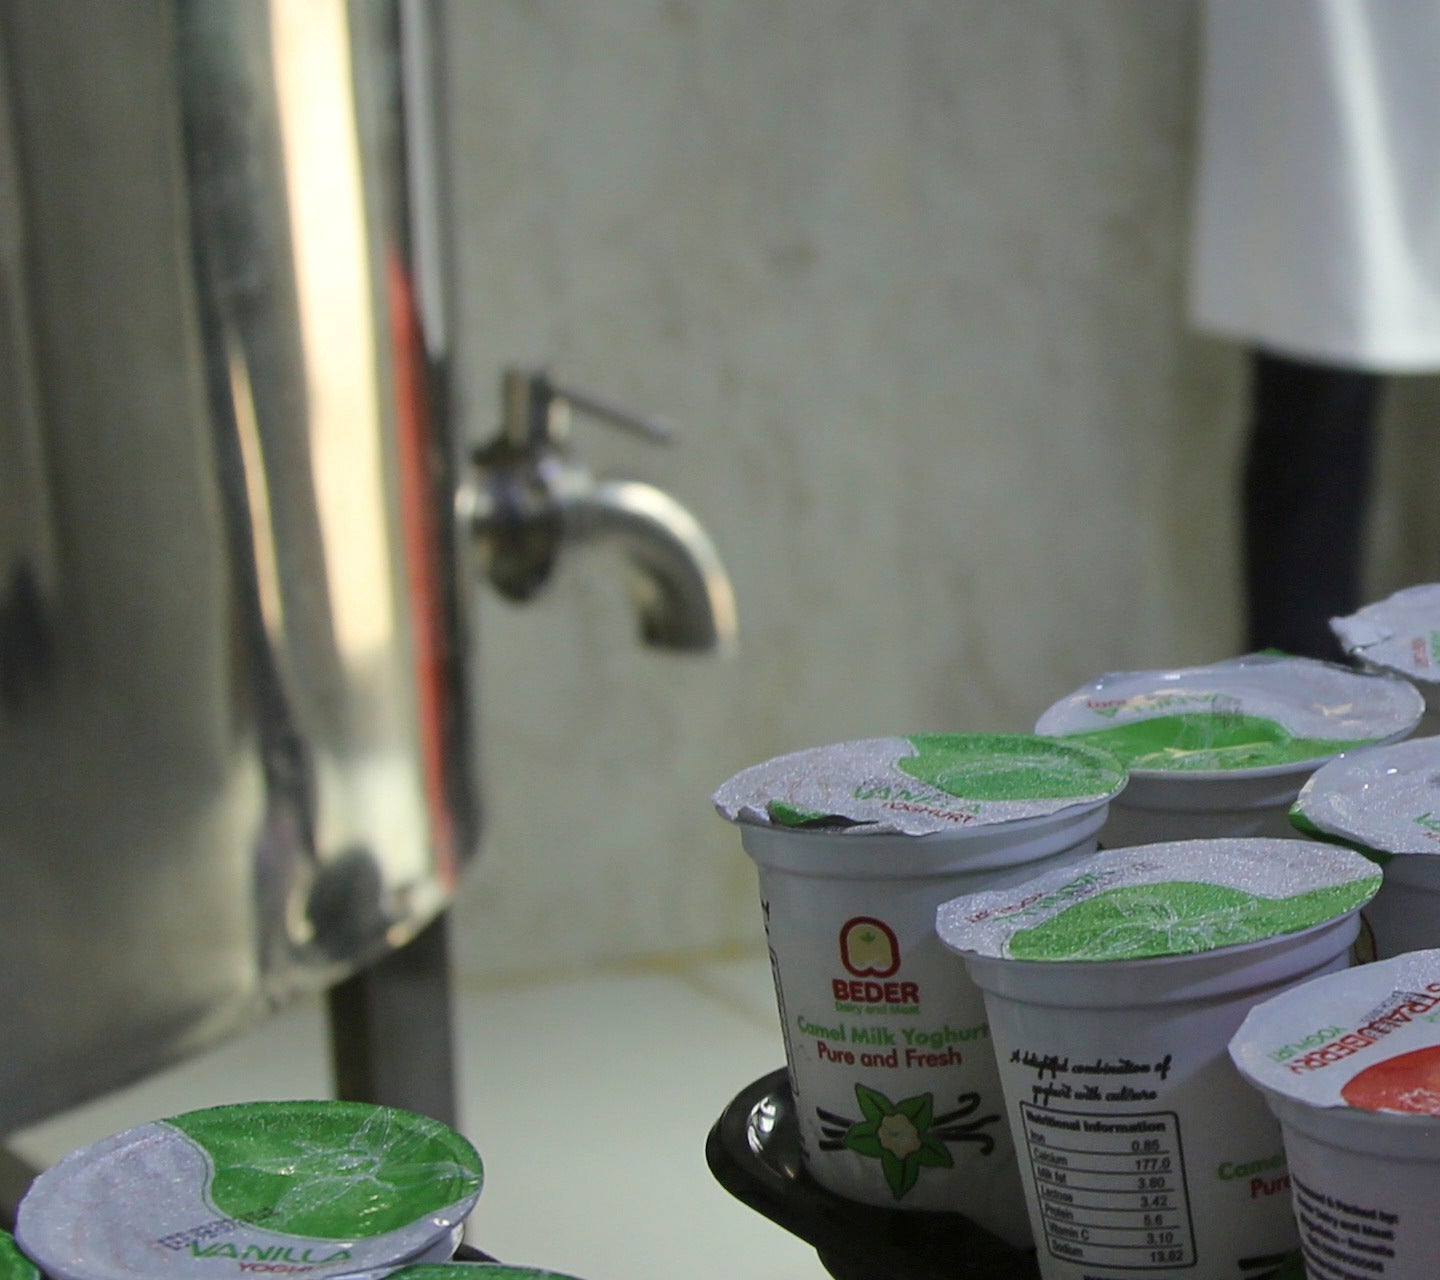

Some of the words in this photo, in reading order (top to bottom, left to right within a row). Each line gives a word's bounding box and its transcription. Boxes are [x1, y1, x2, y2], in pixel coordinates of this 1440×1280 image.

[832, 978, 920, 1004] BEDER
[796, 1015, 847, 1042] Camel
[851, 1026, 896, 1046] Milk
[901, 1021, 989, 1050] Yoghurt
[817, 1040, 855, 1066] Pure
[860, 1049, 898, 1069] and
[905, 1046, 962, 1068] Fresh
[1153, 1053, 1173, 1081] of
[1083, 1119, 1166, 1133] Information
[1135, 1157, 1172, 1171] 177.0
[188, 1237, 355, 1266] VANILLA
